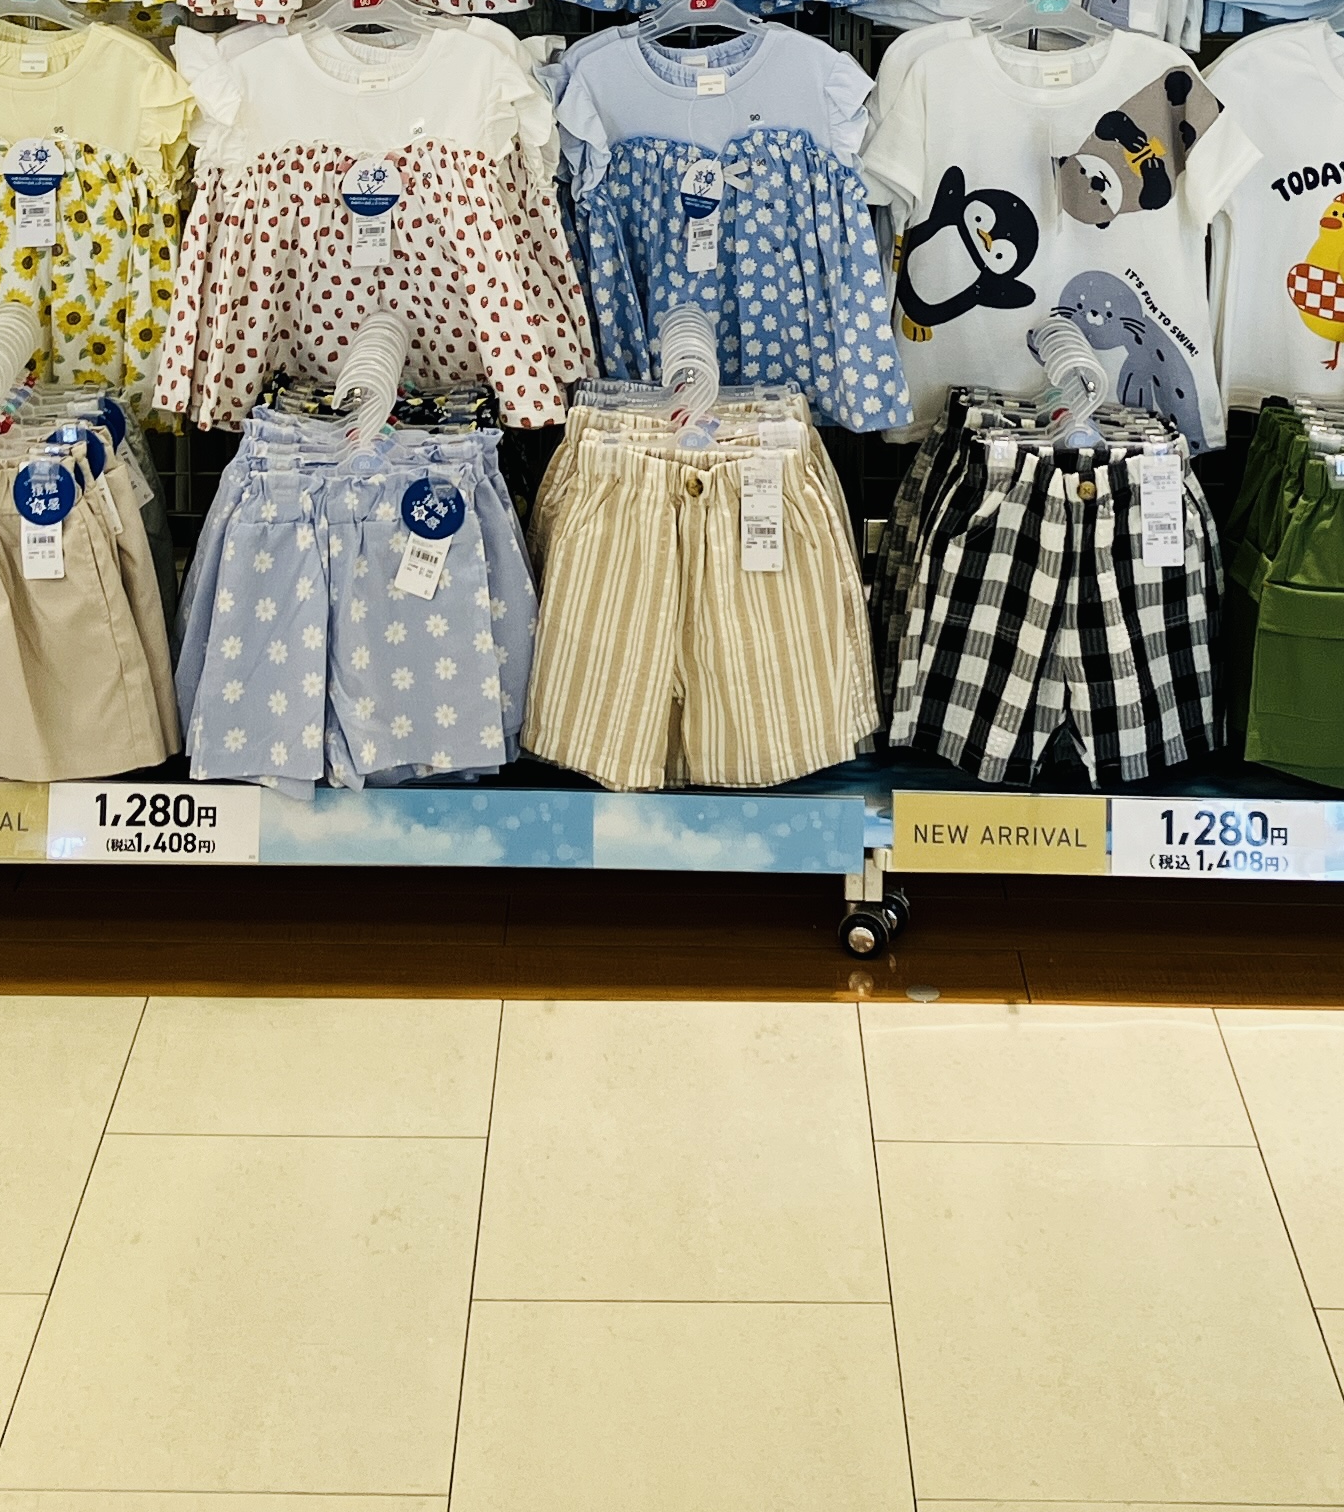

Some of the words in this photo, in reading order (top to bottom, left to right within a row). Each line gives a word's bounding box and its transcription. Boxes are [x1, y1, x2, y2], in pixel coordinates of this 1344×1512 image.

[1124, 268, 1144, 289] IT'S
[1141, 290, 1158, 315] FUN
[1157, 311, 1171, 326] TO
[1170, 325, 1199, 358] SWIM!
[95, 793, 217, 828] 1,280円
[1160, 810, 1288, 846] 1,280円
[913, 824, 969, 844] NEW
[980, 825, 1087, 848] ARRIVAL
